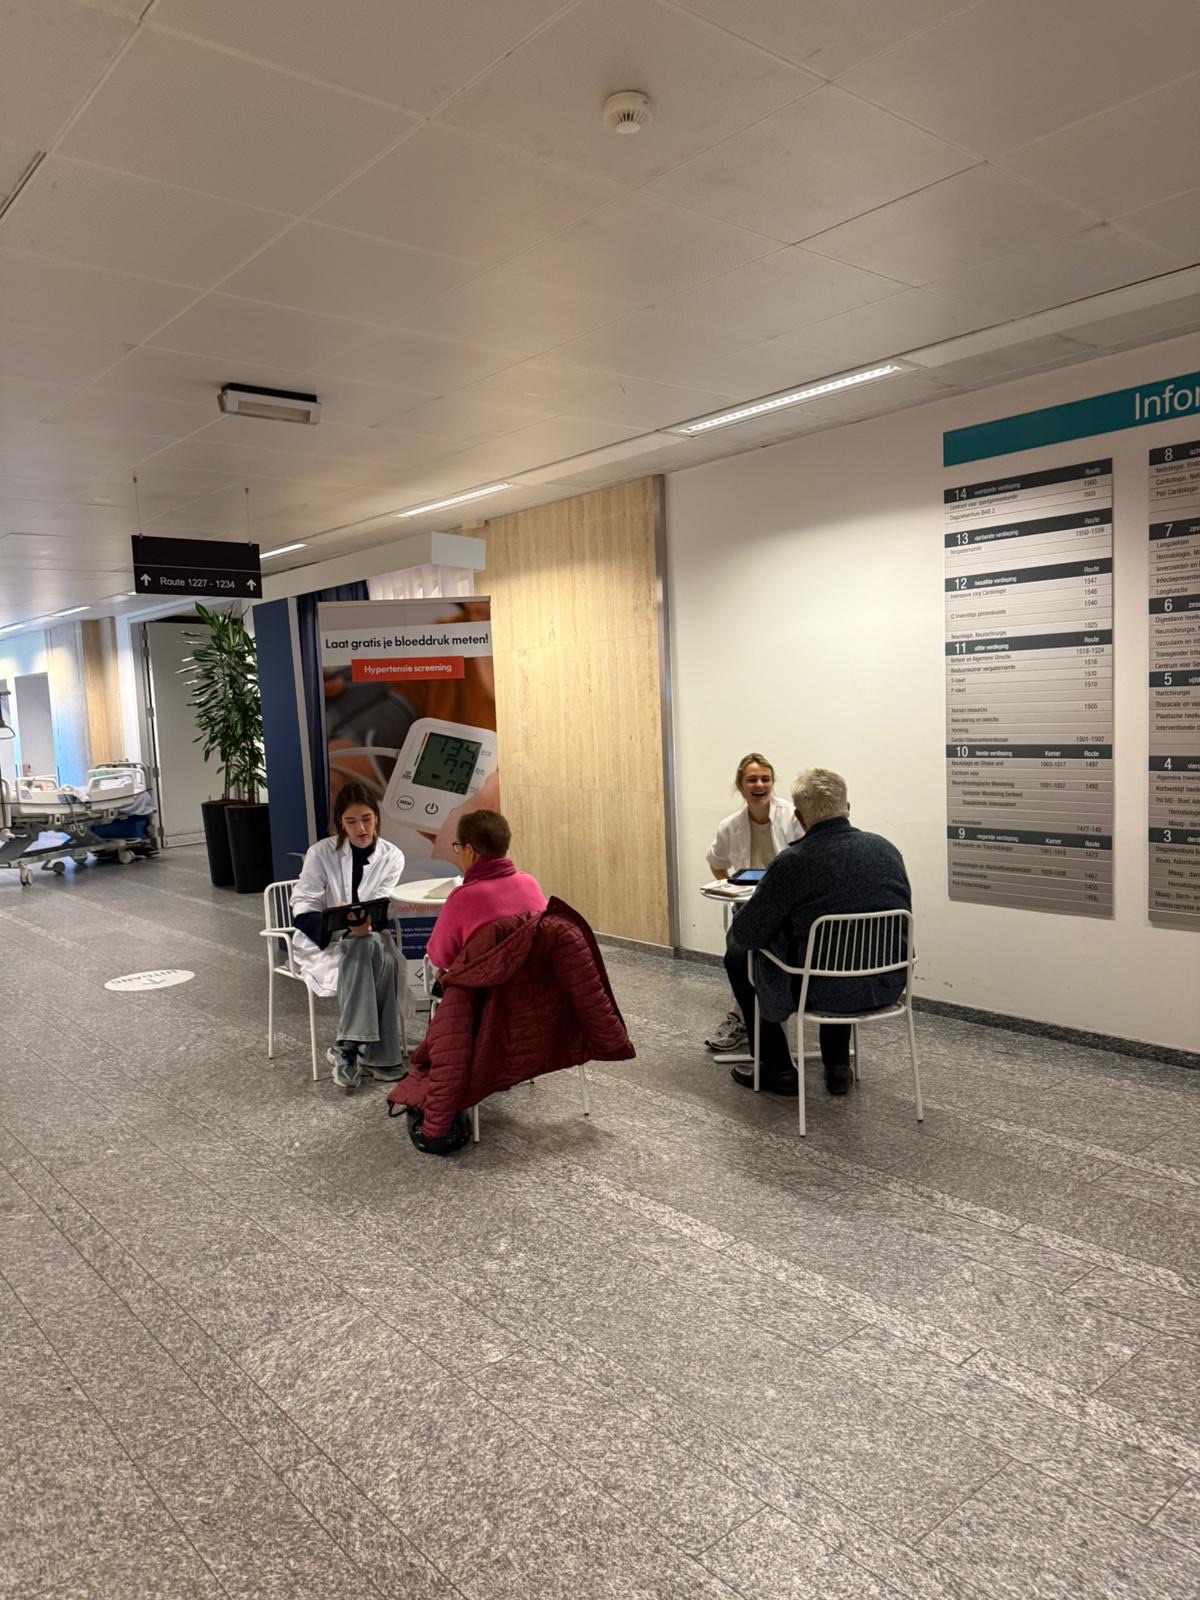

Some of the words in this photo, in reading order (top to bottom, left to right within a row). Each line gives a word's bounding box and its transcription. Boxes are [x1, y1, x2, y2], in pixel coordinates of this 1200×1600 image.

[1165, 447, 1173, 461] 8
[955, 487, 967, 501] 14
[1165, 523, 1173, 537] 7
[956, 532, 969, 545] 13
[160, 577, 185, 587] Route
[189, 578, 208, 588] 1227
[216, 580, 235, 590] 1234
[955, 577, 967, 590] 12
[1164, 598, 1173, 612] 6
[325, 638, 349, 649] Laat
[351, 637, 381, 651] gratis
[382, 637, 393, 650] je
[395, 635, 450, 647] bloeddruk
[452, 633, 489, 645] meten!
[955, 642, 966, 655] 11
[364, 665, 413, 675] Hypertensie
[414, 663, 452, 673] screening
[1163, 672, 1172, 686] 5
[956, 746, 968, 758] 10
[1163, 757, 1172, 771] 4
[958, 827, 966, 839] 9
[1085, 840, 1101, 848] Route
[1163, 829, 1172, 843] 3
